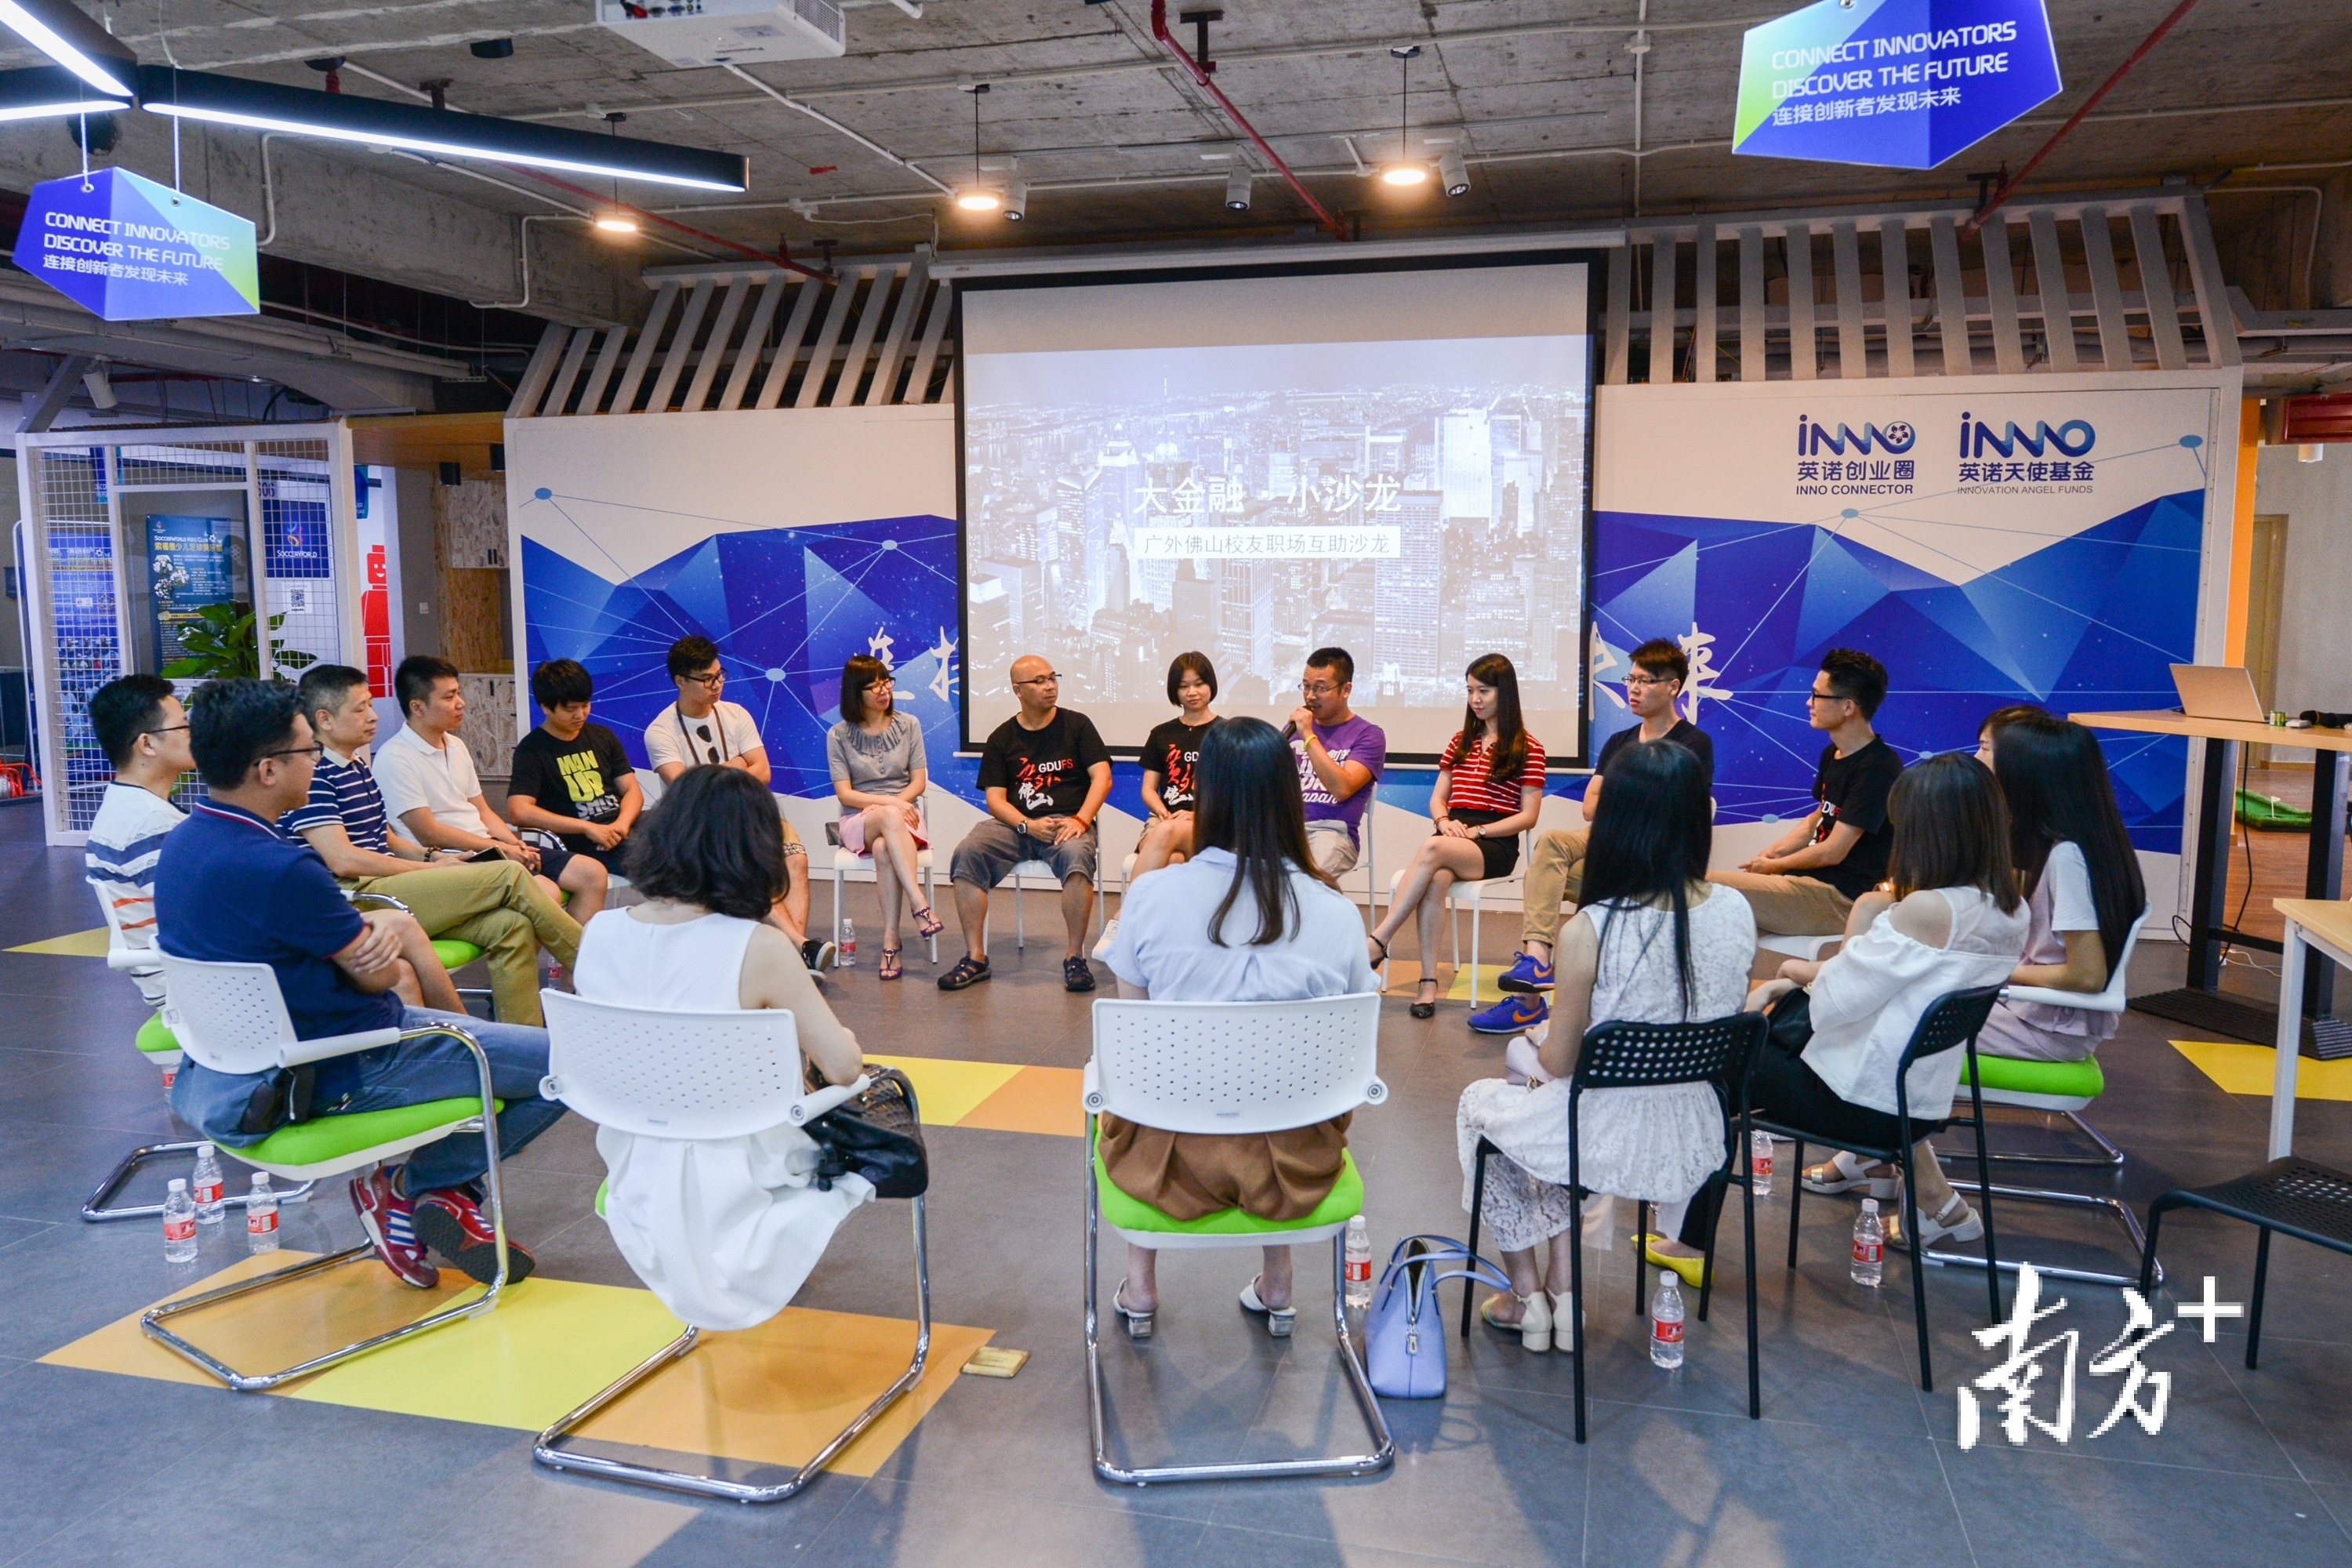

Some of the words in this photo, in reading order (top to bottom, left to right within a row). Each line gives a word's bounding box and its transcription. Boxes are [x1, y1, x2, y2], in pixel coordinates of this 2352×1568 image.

[1772, 39, 1869, 70] CONNECT
[1873, 20, 2016, 58] INNOVATORS
[1772, 70, 1874, 100] DISCOVER
[1878, 64, 1920, 87] THE
[1924, 52, 2009, 80] FUTURE
[1772, 86, 1962, 127] 连接创新者发现未来
[45, 211, 122, 235] CONNECT
[125, 222, 230, 250] INNOVATORS
[44, 234, 123, 258] DISCOVER
[127, 245, 159, 263] THE
[162, 250, 223, 270] FUTURE
[42, 254, 189, 285] 连接创新者发现未来
[1797, 460, 1915, 481] 英诺创业圈
[1958, 461, 2095, 482] 英诺天使基金
[1796, 485, 1828, 495] INNO
[1831, 484, 1913, 495] CONNECTOR
[1958, 486, 2020, 495] INNOVATION
[2021, 485, 2055, 494] ANGEL
[2058, 485, 2093, 494] FUNDS
[1144, 533, 1391, 554] 广外佛山校友职场互助沙龙
[556, 750, 599, 775] MAN
[1038, 758, 1073, 773] GDUFS
[563, 770, 605, 802] UP
[1302, 792, 1338, 804] apan
